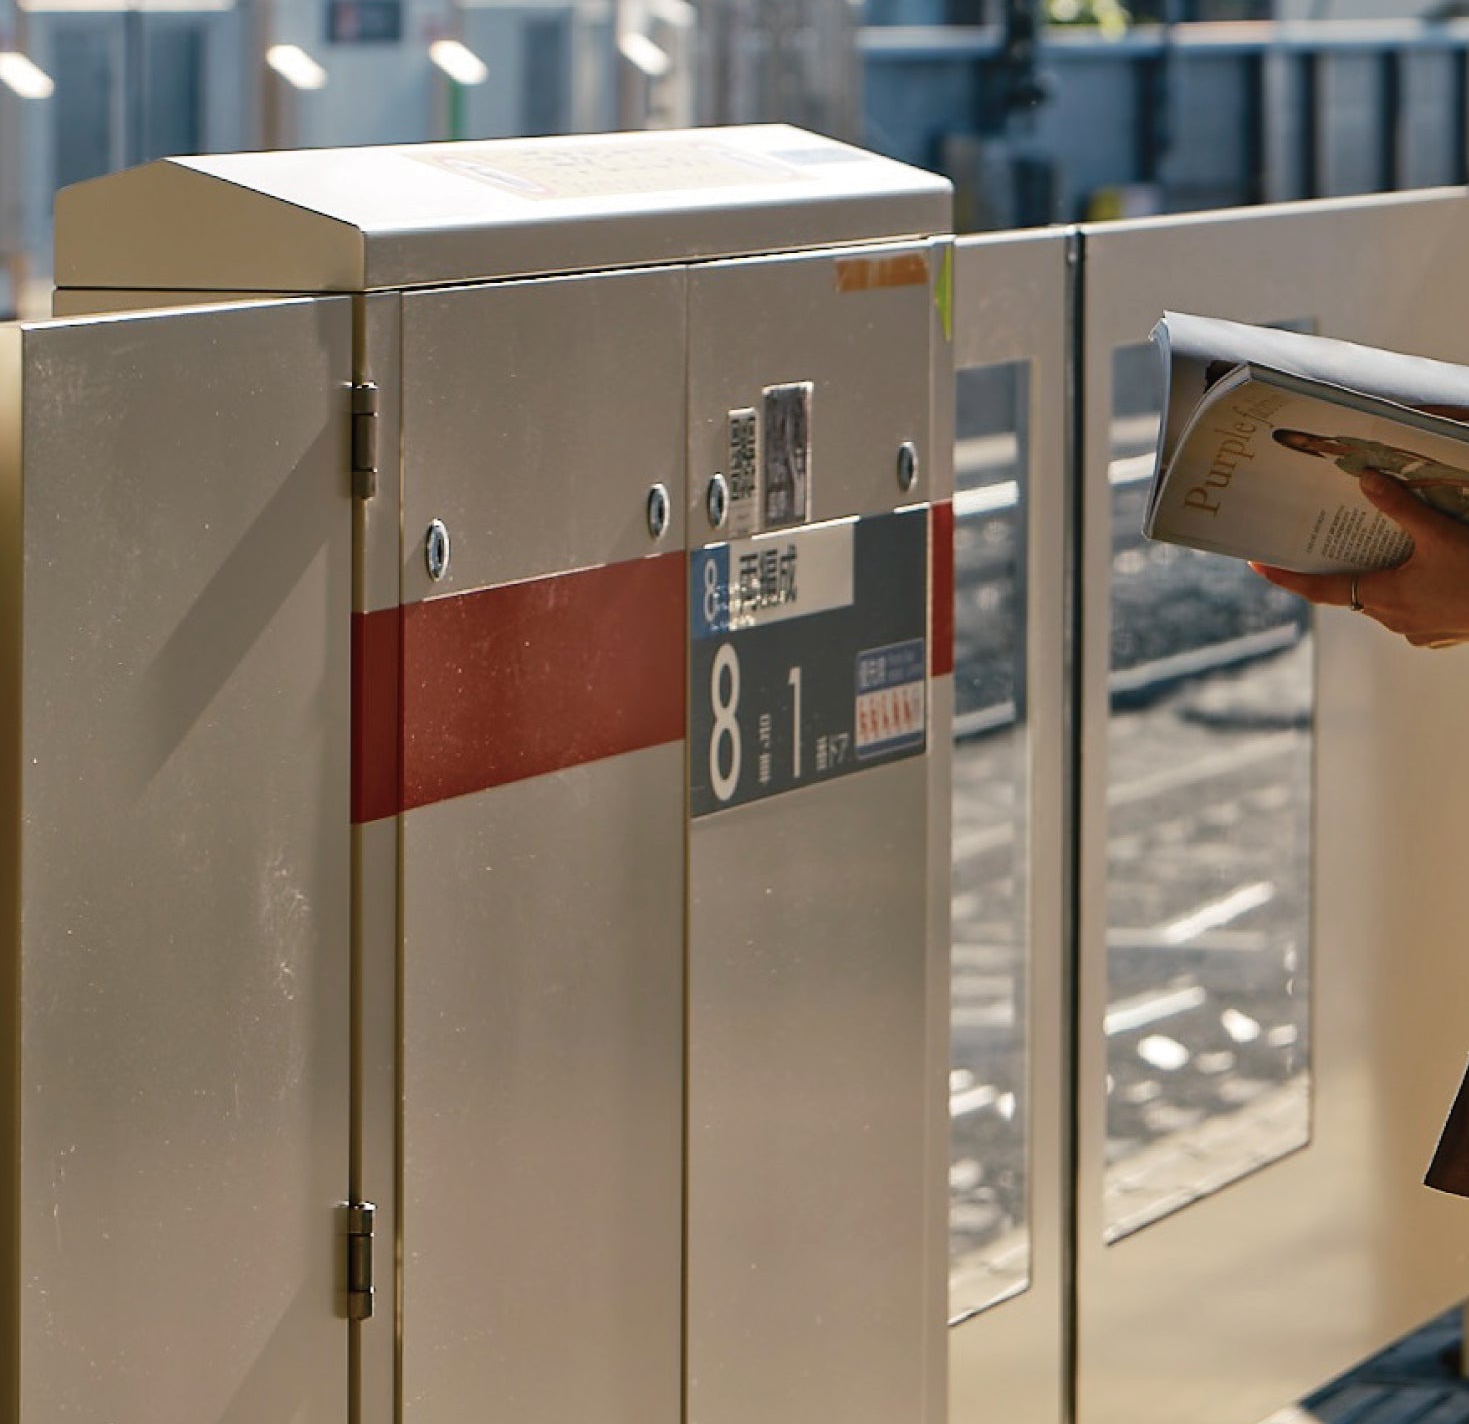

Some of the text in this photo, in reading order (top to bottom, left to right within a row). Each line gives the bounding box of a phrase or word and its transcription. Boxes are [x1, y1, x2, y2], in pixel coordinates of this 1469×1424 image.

[1184, 422, 1257, 518] Purple
[704, 558, 718, 623] 8
[709, 642, 742, 802] 8
[787, 666, 802, 778] 1
